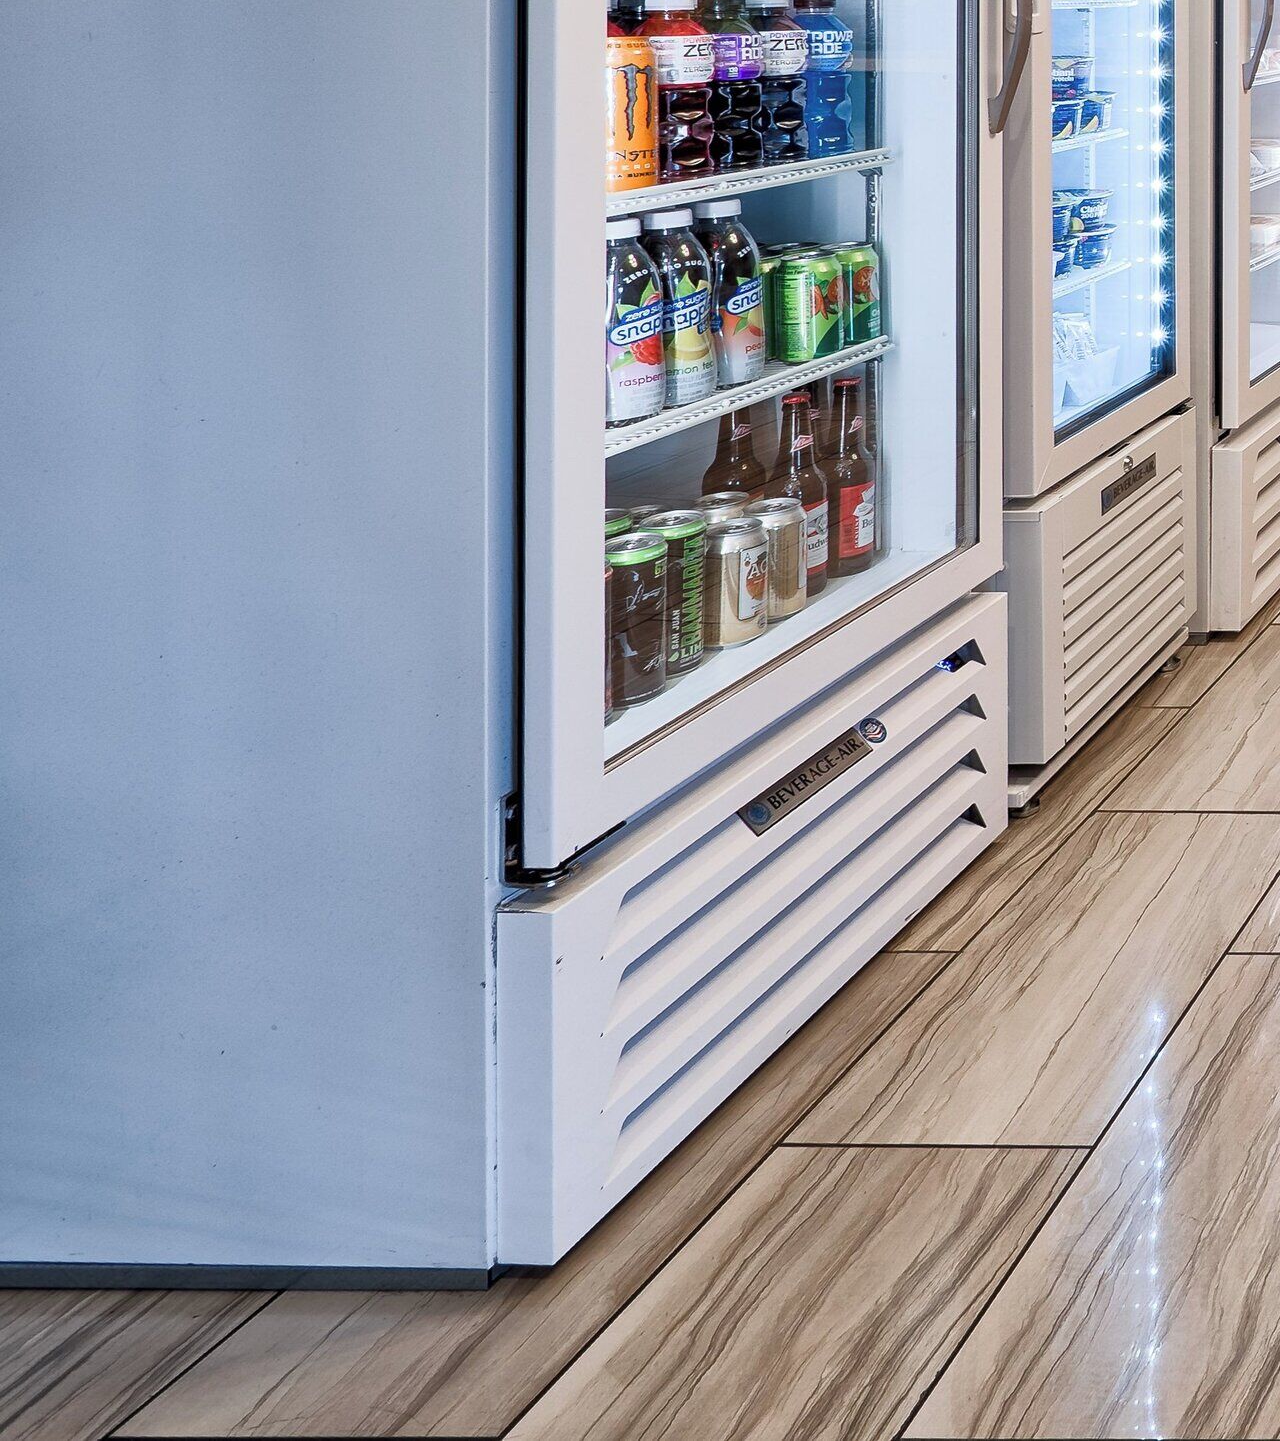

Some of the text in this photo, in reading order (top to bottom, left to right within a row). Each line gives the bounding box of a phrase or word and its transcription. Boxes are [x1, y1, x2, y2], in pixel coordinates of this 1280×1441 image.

[666, 364, 699, 377] emon
[671, 609, 680, 650] SAN JUAN
[680, 641, 704, 658] LIM
